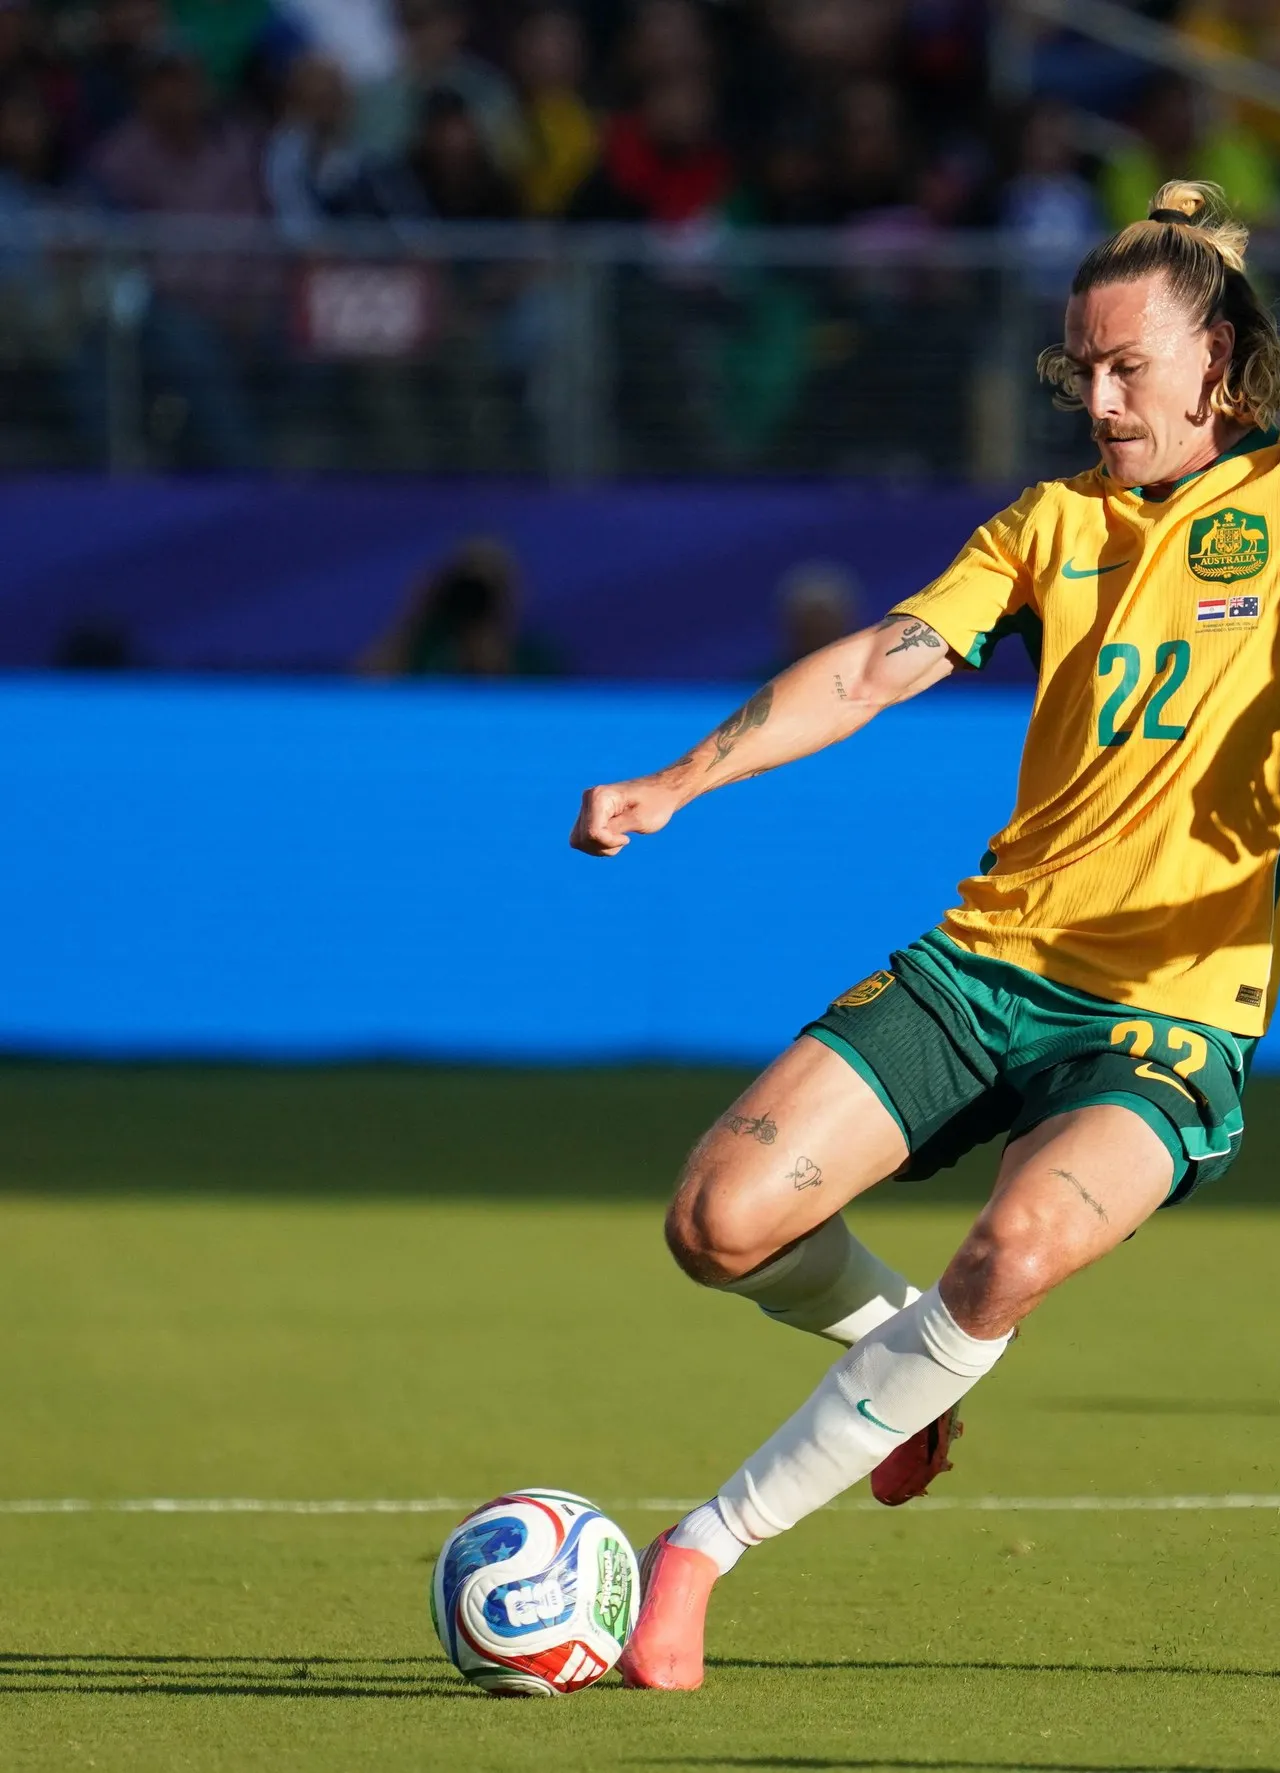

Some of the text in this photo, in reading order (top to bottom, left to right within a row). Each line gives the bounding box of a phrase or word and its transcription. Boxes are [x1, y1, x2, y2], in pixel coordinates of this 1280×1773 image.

[1200, 554, 1256, 565] AUSTRALIA
[833, 674, 847, 700] FEEL
[1097, 639, 1191, 747] 22
